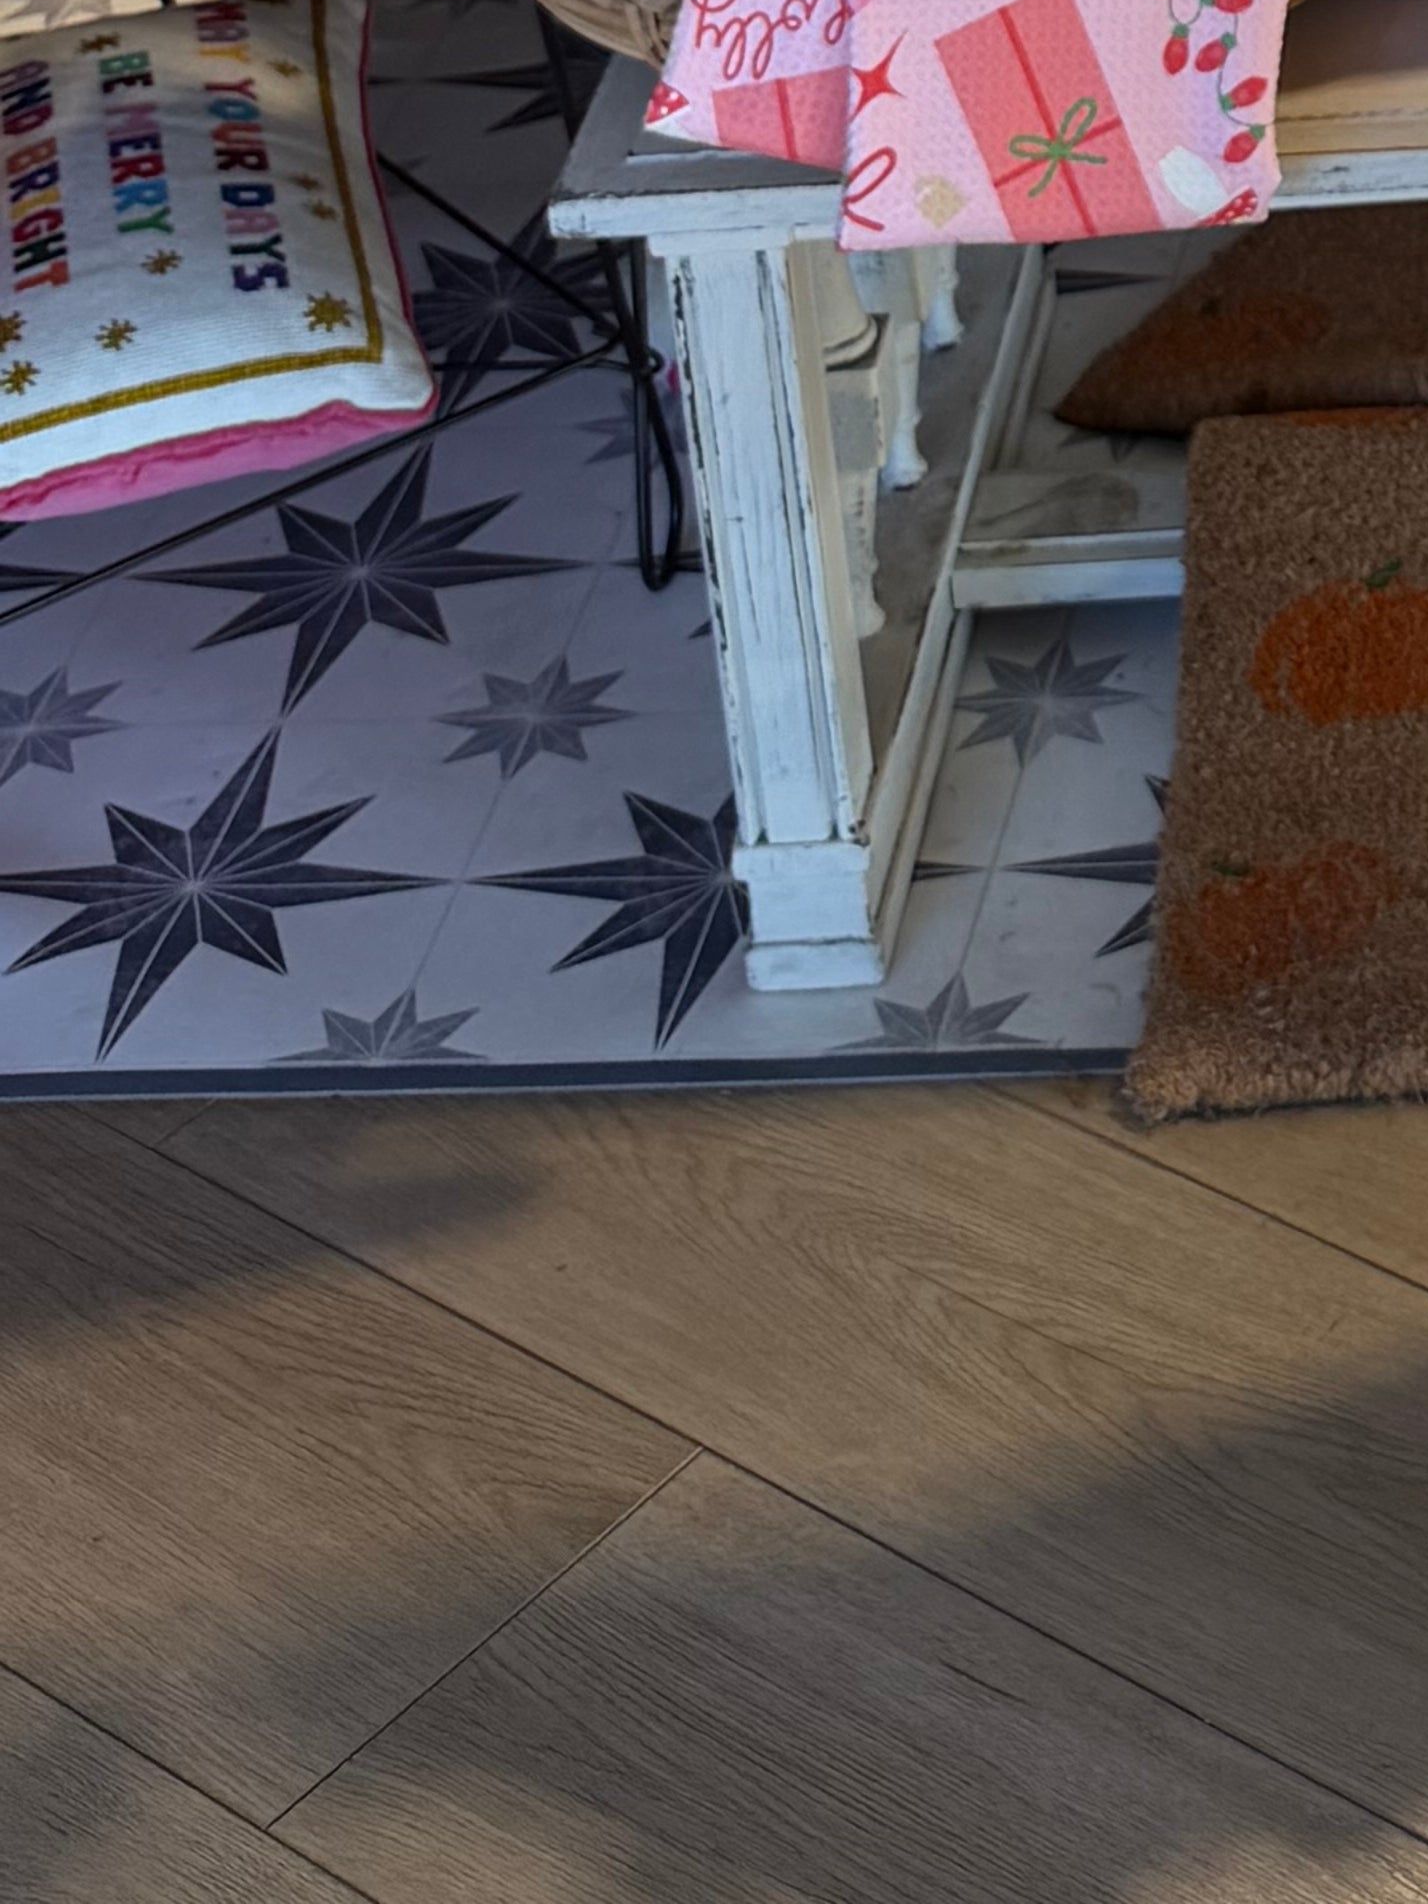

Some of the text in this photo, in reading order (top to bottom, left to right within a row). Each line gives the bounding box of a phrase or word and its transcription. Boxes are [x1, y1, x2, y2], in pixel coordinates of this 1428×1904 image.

[0, 59, 71, 293] AND BRIGHT
[99, 50, 175, 234] BE MERRY
[203, 77, 271, 173] YOUR
[219, 183, 291, 292] DAYS
